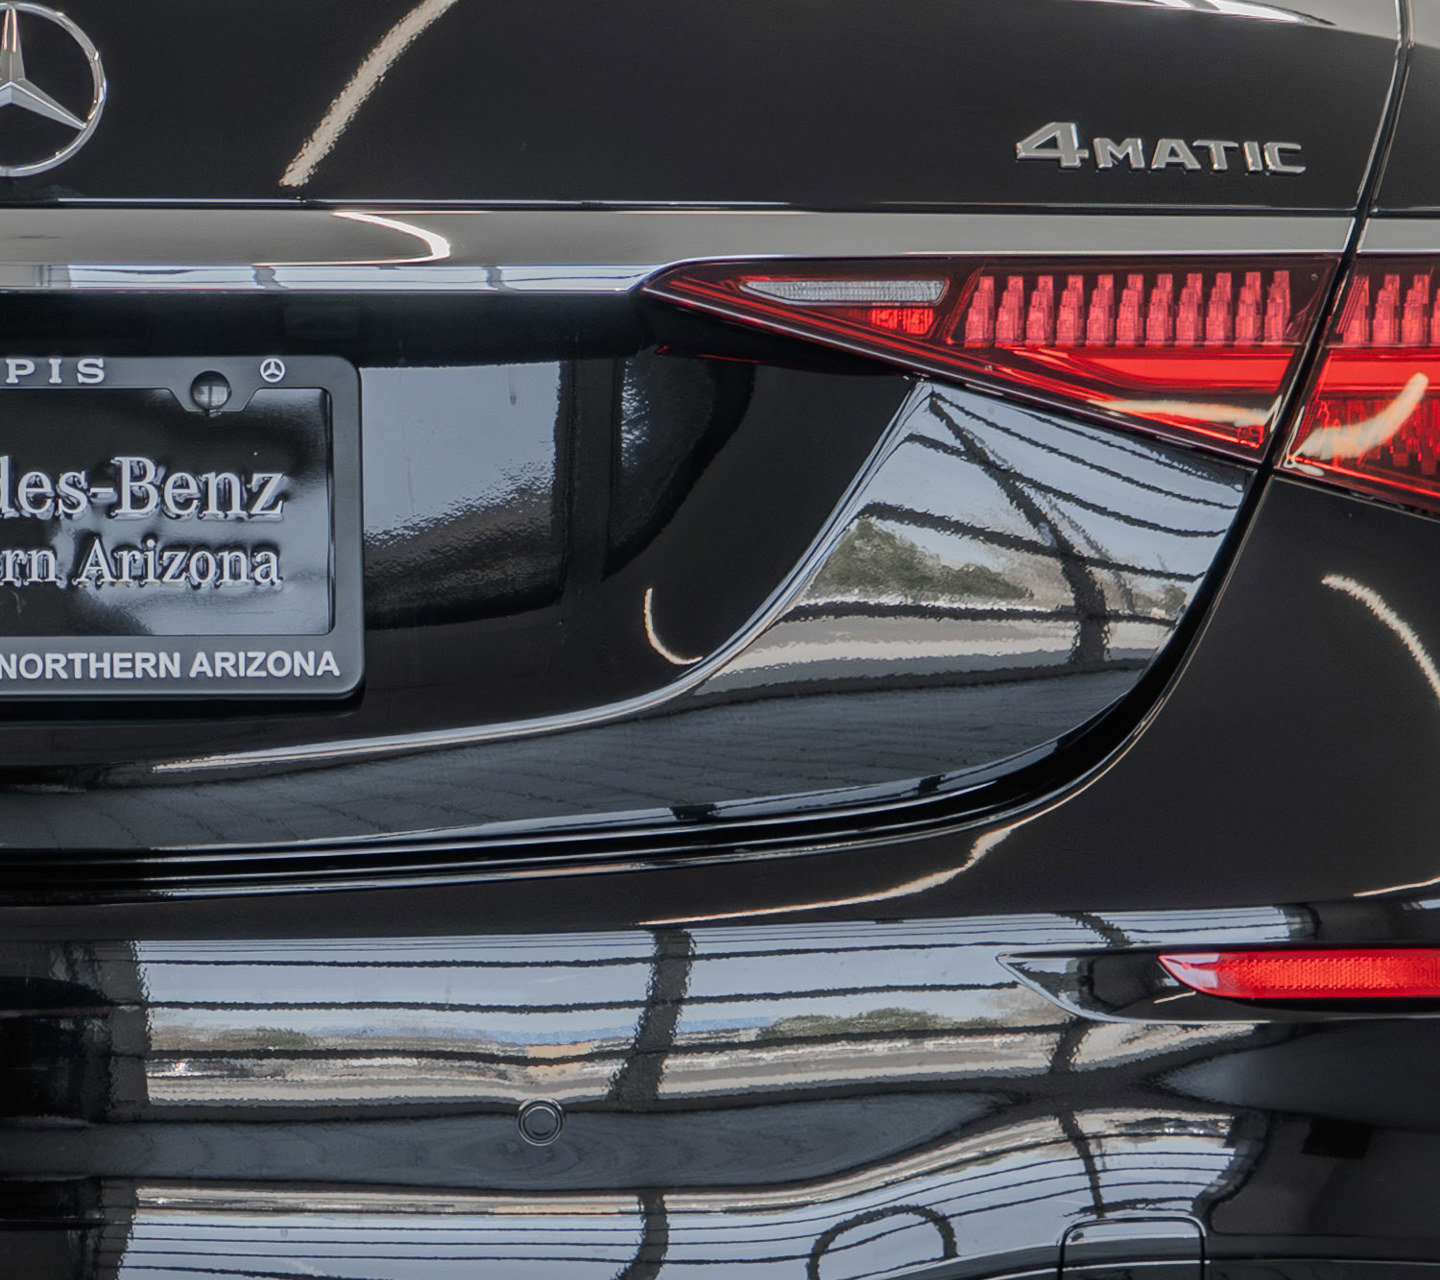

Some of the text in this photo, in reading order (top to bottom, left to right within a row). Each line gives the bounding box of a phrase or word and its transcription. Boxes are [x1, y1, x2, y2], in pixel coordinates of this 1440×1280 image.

[1016, 121, 1306, 174] 4MATIC
[76, 538, 283, 587] Arizona
[188, 650, 341, 678] ARIZONA
